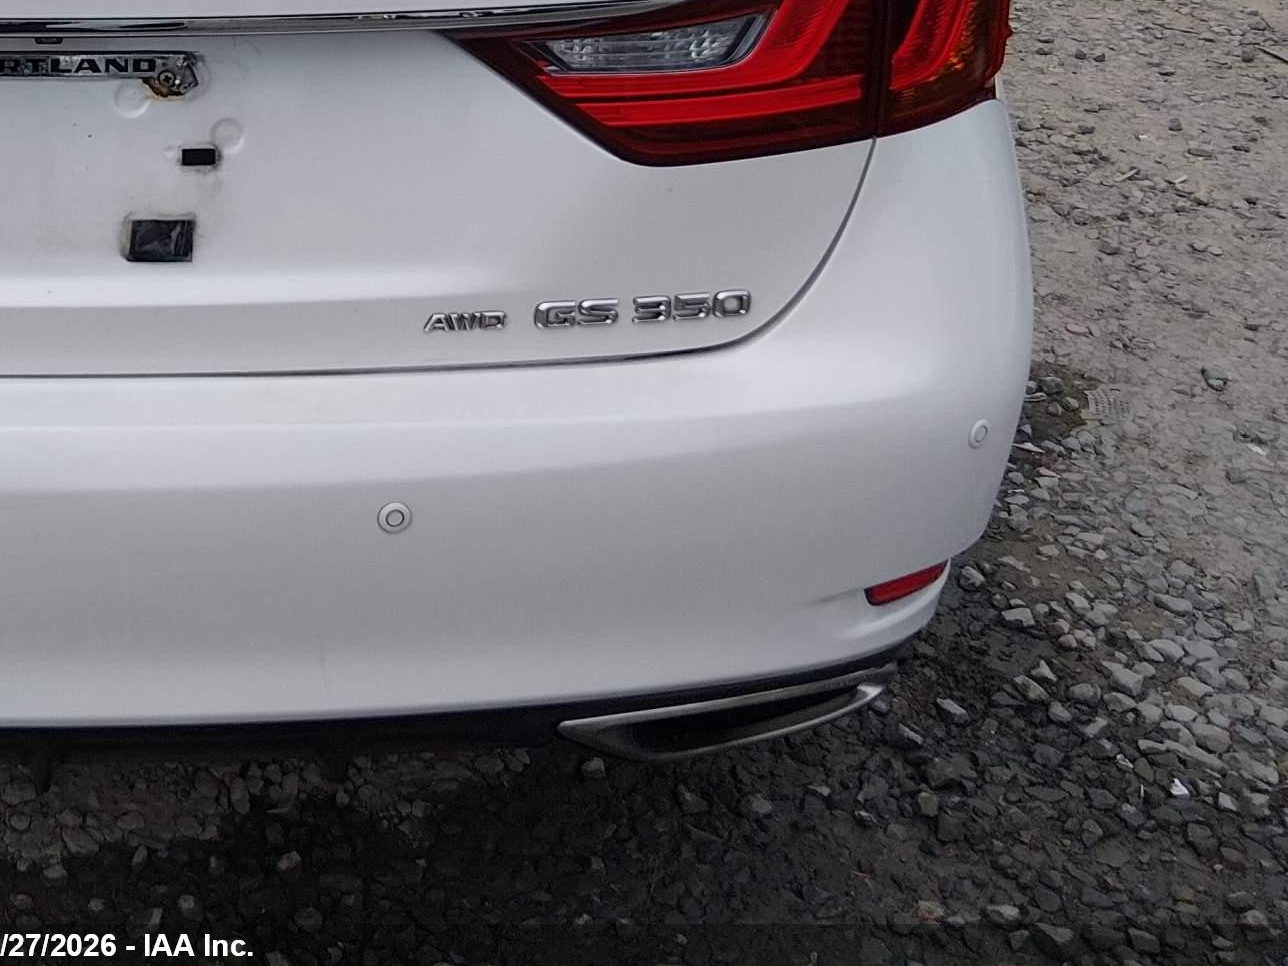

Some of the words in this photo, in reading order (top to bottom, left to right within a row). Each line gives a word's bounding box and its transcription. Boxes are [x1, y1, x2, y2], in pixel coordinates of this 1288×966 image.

[424, 310, 508, 333] AWD
[534, 298, 619, 330] GS
[632, 289, 752, 325] 350
